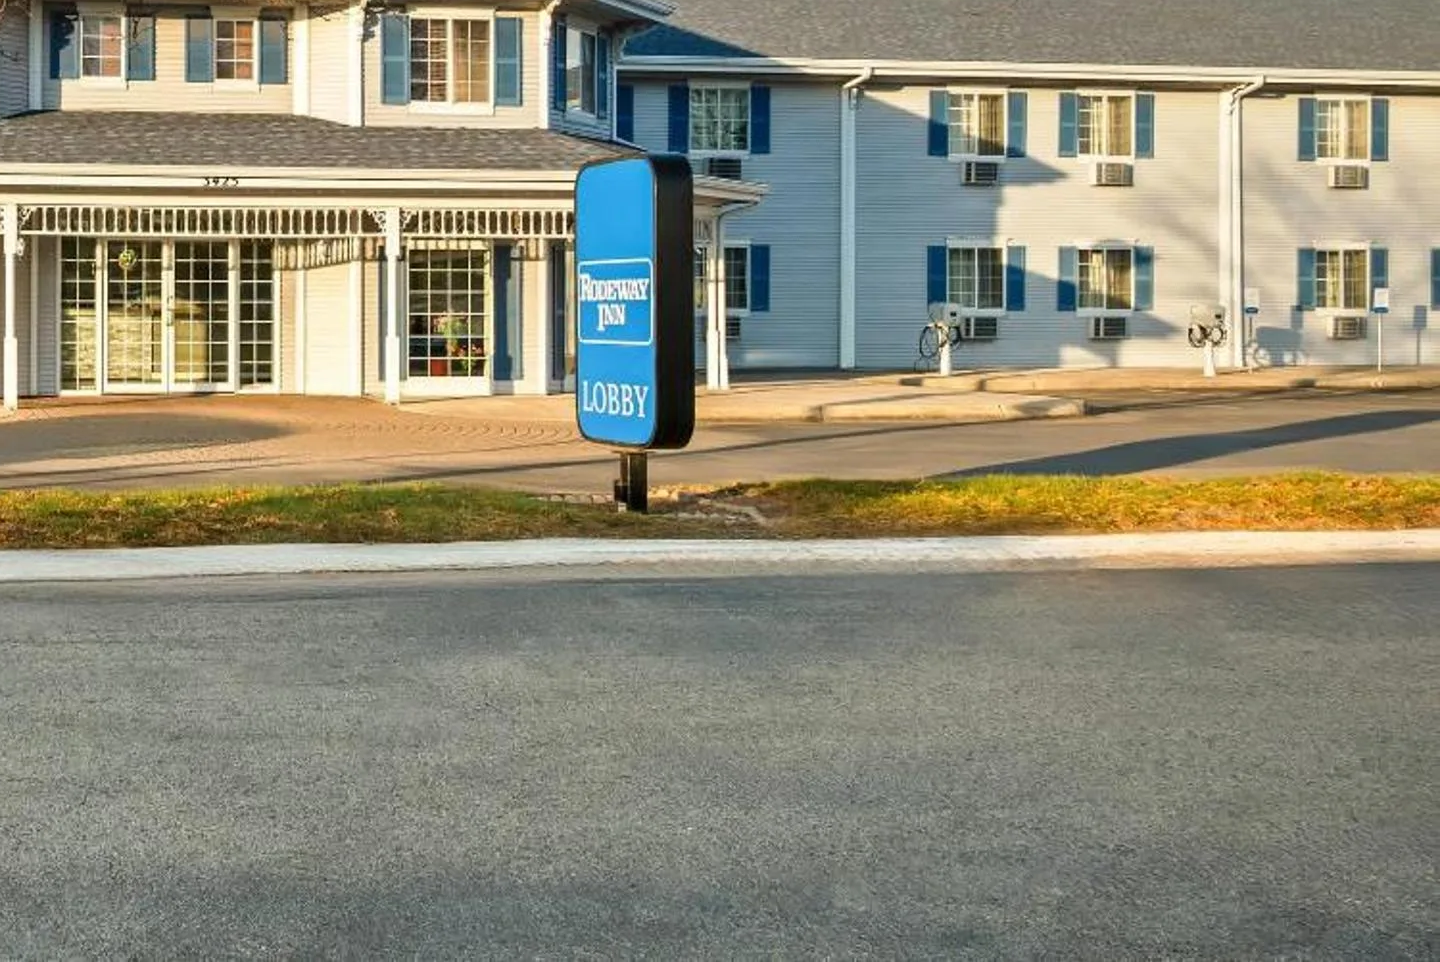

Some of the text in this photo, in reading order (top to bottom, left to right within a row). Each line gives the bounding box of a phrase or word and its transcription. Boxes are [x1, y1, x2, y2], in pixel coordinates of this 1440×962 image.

[579, 273, 649, 302] RODEWAY
[596, 304, 626, 331] INN
[583, 380, 649, 418] LOBBY
